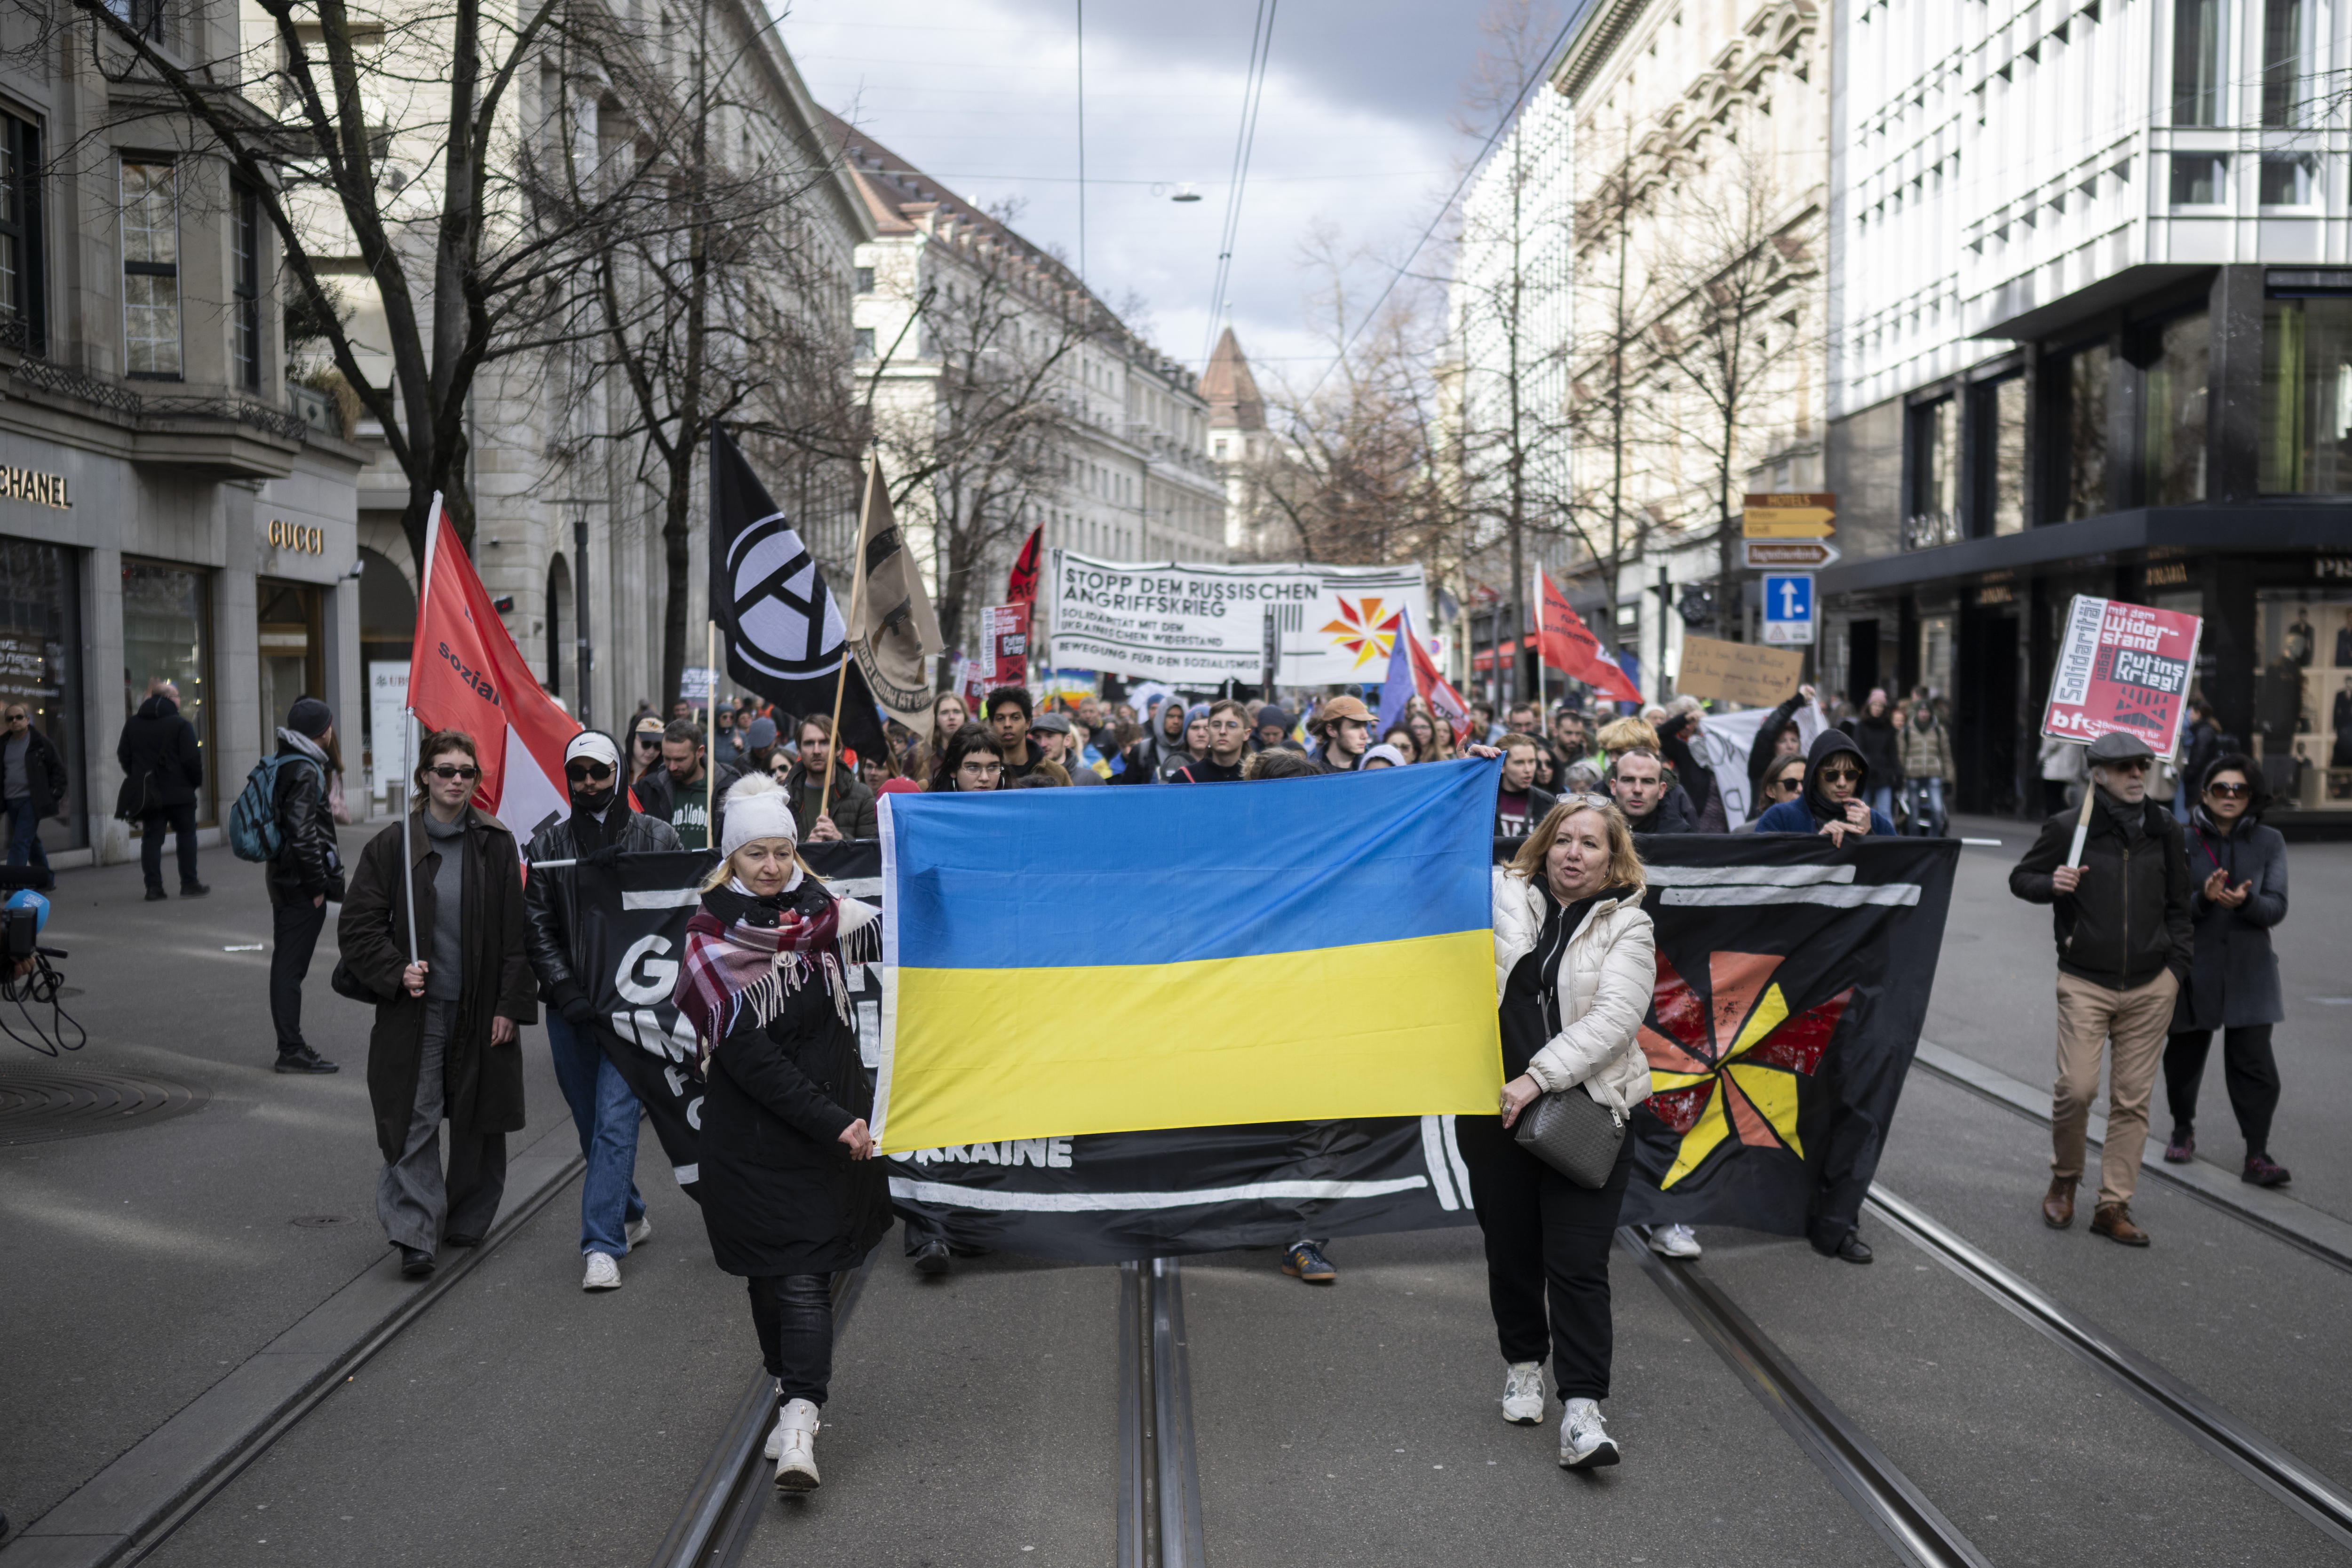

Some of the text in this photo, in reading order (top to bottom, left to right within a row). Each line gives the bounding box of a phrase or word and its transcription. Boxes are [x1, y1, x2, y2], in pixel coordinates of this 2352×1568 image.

[1767, 494, 1811, 506] HOTELS
[269, 519, 323, 556] GUCCI
[1065, 568, 1318, 600] STOPP DEM RUSSISCHEN
[1064, 585, 1226, 618] ANGRIFFSKRIEG
[2108, 605, 2155, 621] mit dem
[1061, 608, 1184, 632] SOLIDARITÄT MIT DEM
[2105, 615, 2179, 639] Wider-
[1061, 621, 1224, 647] UKRAINISCHEN WIDERSTAND
[2101, 631, 2159, 653] stand
[1059, 642, 1260, 669] BEWEGUNG FÜR DEN SOZIALISMUS
[2059, 599, 2102, 701] Solidarität
[437, 642, 501, 706] sozial
[2117, 650, 2185, 678] Putins
[2115, 664, 2178, 692] Krieg!
[2102, 721, 2161, 740] Bewegung für
